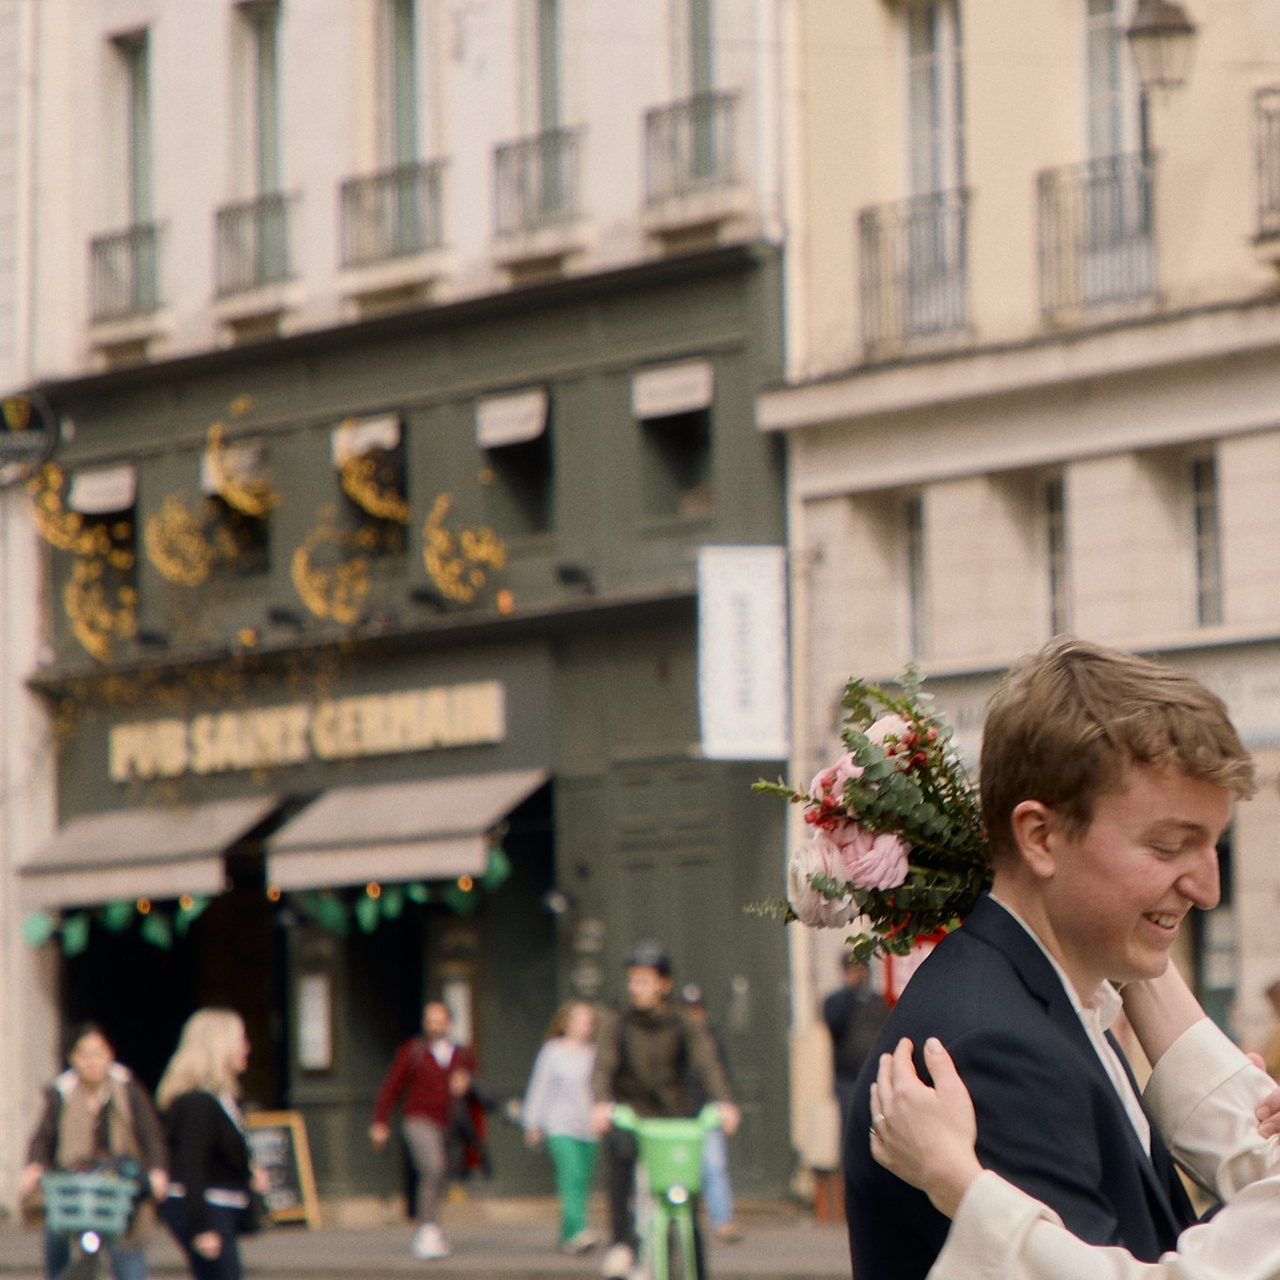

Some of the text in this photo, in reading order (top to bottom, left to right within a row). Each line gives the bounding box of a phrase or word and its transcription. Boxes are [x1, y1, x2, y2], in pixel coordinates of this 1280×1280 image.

[109, 680, 506, 783] PUB SAINT GERMAIN
